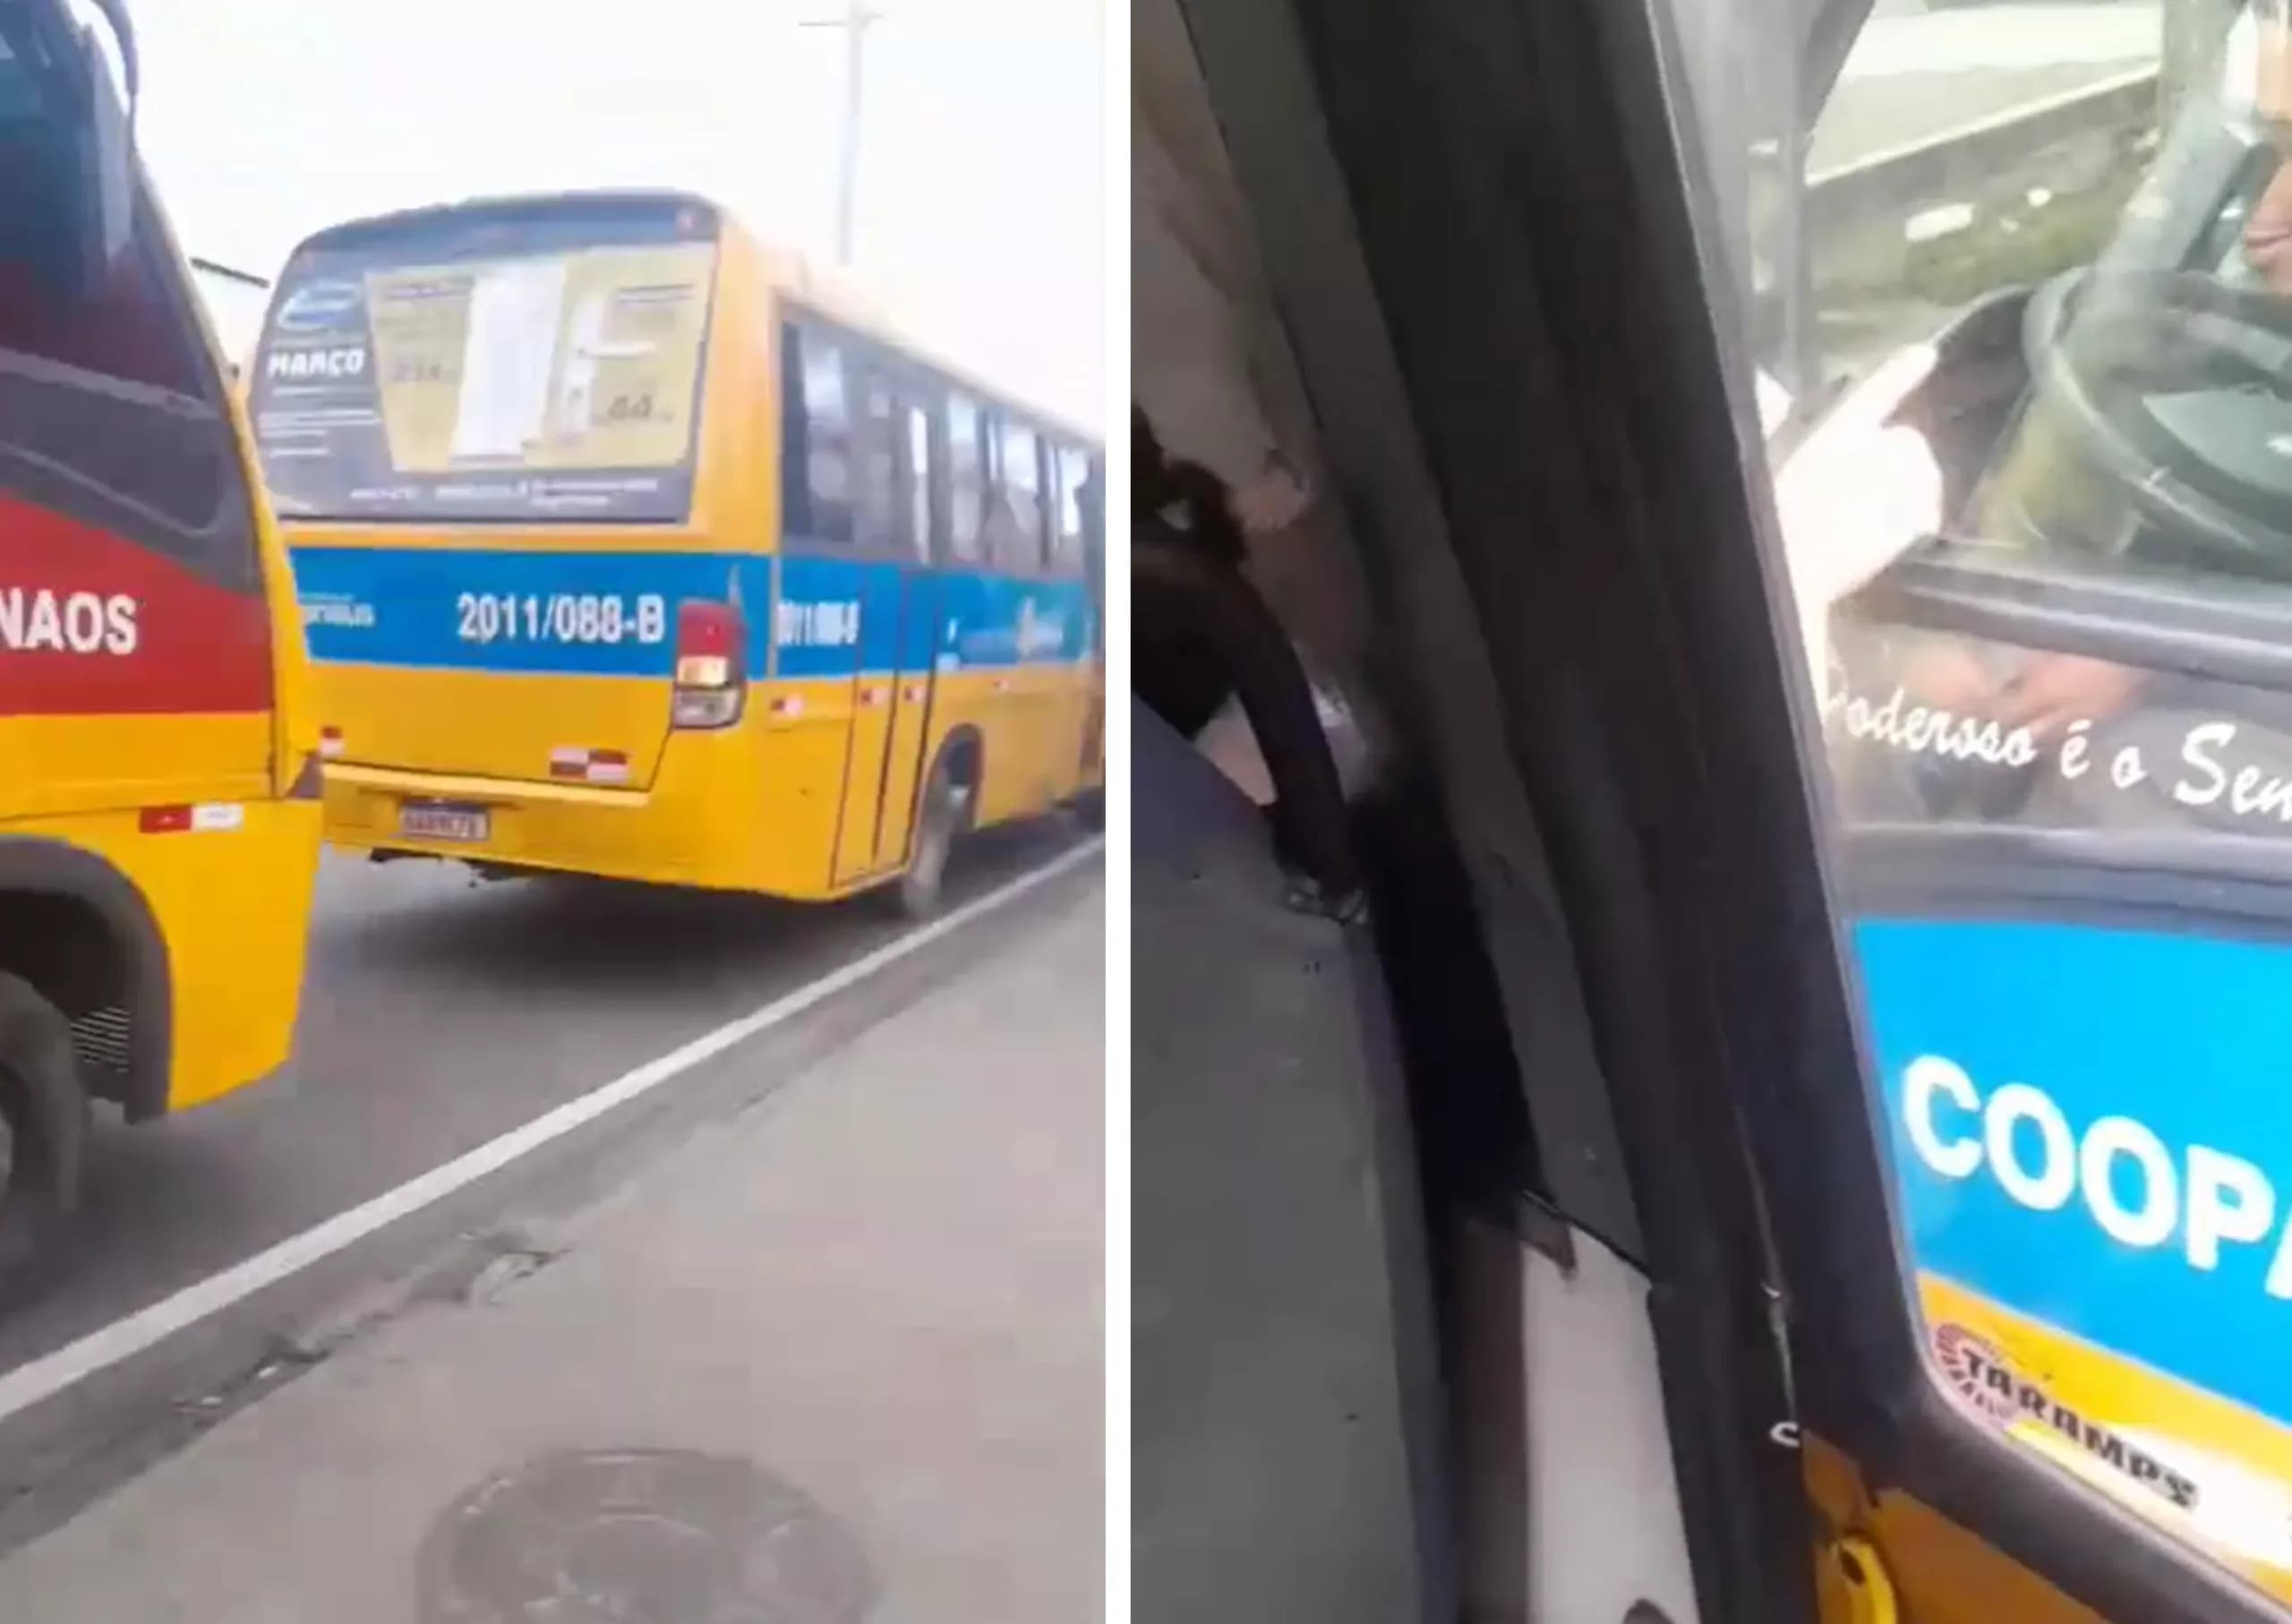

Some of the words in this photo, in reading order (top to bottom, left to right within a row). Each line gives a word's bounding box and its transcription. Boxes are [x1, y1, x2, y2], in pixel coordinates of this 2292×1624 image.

[457, 591, 665, 643] 2011/088-B
[2060, 718, 2091, 779] é
[2110, 746, 2147, 790] o
[2173, 722, 2292, 822] Sen
[1961, 1346, 2196, 1508] TARAMPS
